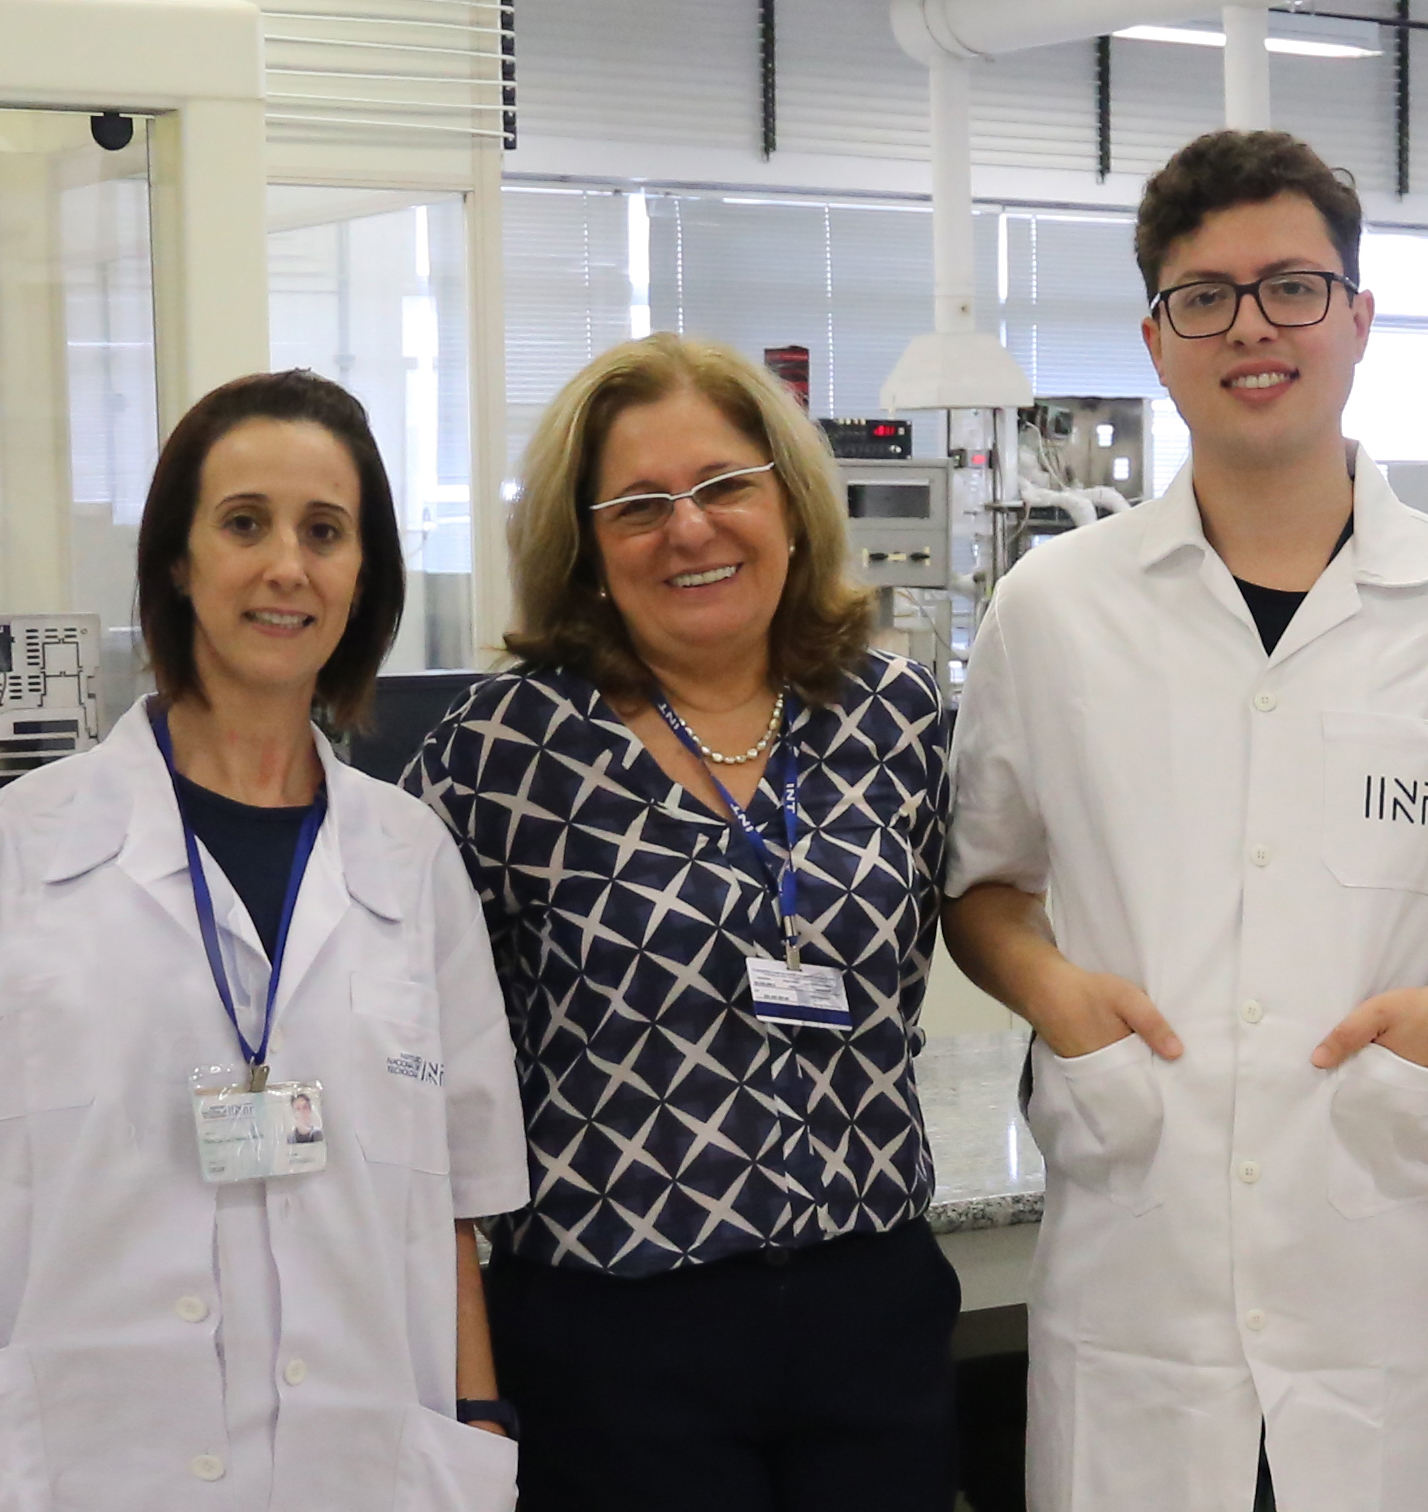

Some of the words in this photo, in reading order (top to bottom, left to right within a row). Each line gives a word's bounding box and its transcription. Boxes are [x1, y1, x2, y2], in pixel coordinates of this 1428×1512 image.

[657, 702, 681, 731] INT
[785, 783, 797, 815] INT
[729, 802, 755, 833] INT
